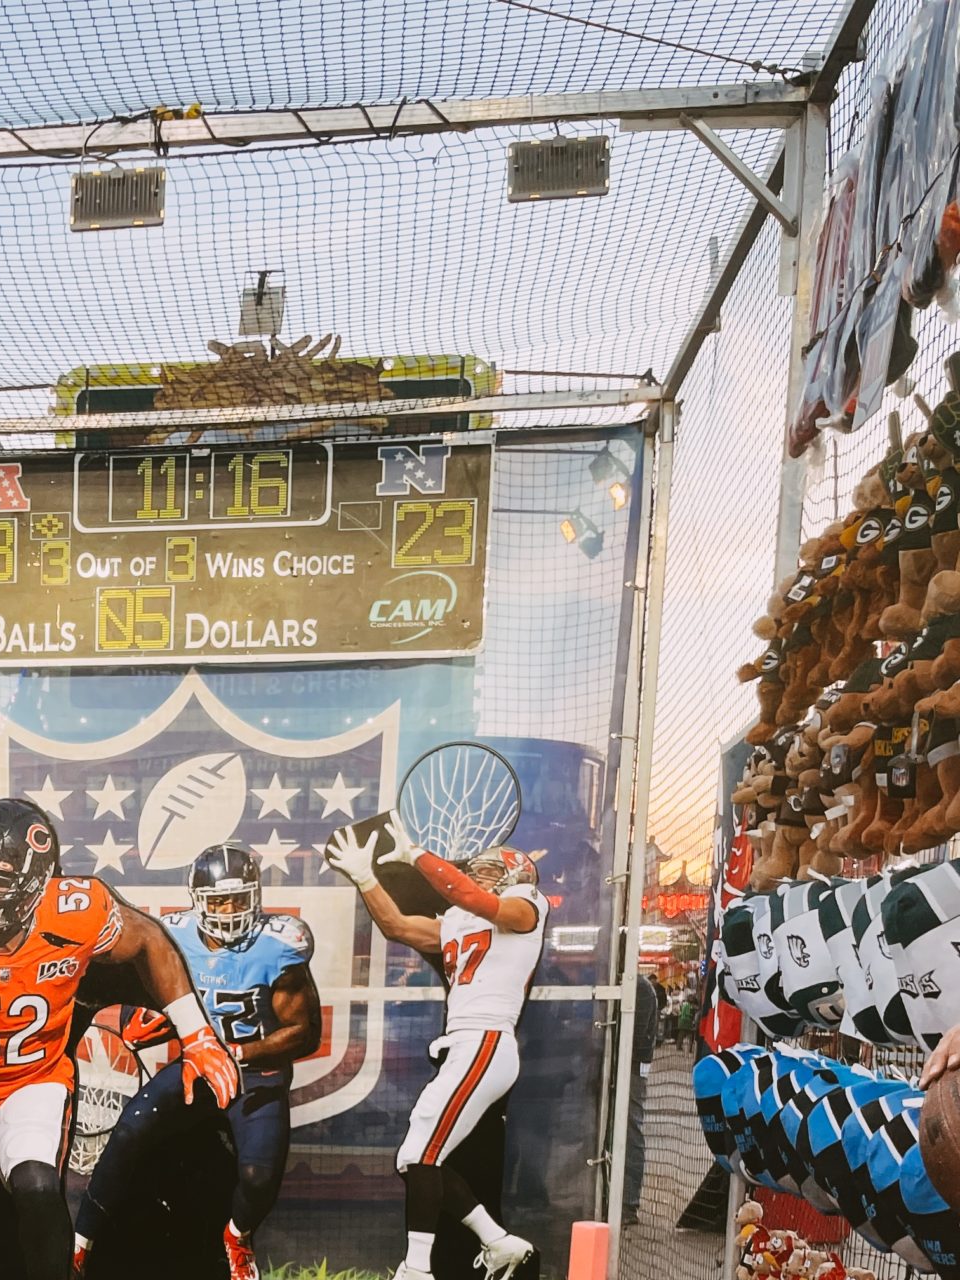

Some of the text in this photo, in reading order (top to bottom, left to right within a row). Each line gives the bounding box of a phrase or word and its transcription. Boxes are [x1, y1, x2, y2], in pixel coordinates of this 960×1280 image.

[136, 454, 288, 519] 11:16
[375, 446, 451, 496] N
[394, 501, 473, 565] 23
[857, 520, 880, 544] G
[905, 506, 928, 529] G
[42, 542, 70, 585] 3
[167, 538, 196, 581] 3
[369, 599, 448, 622] CAM
[203, 674, 257, 697] HILI
[266, 675, 281, 695] &
[58, 879, 91, 914] 52
